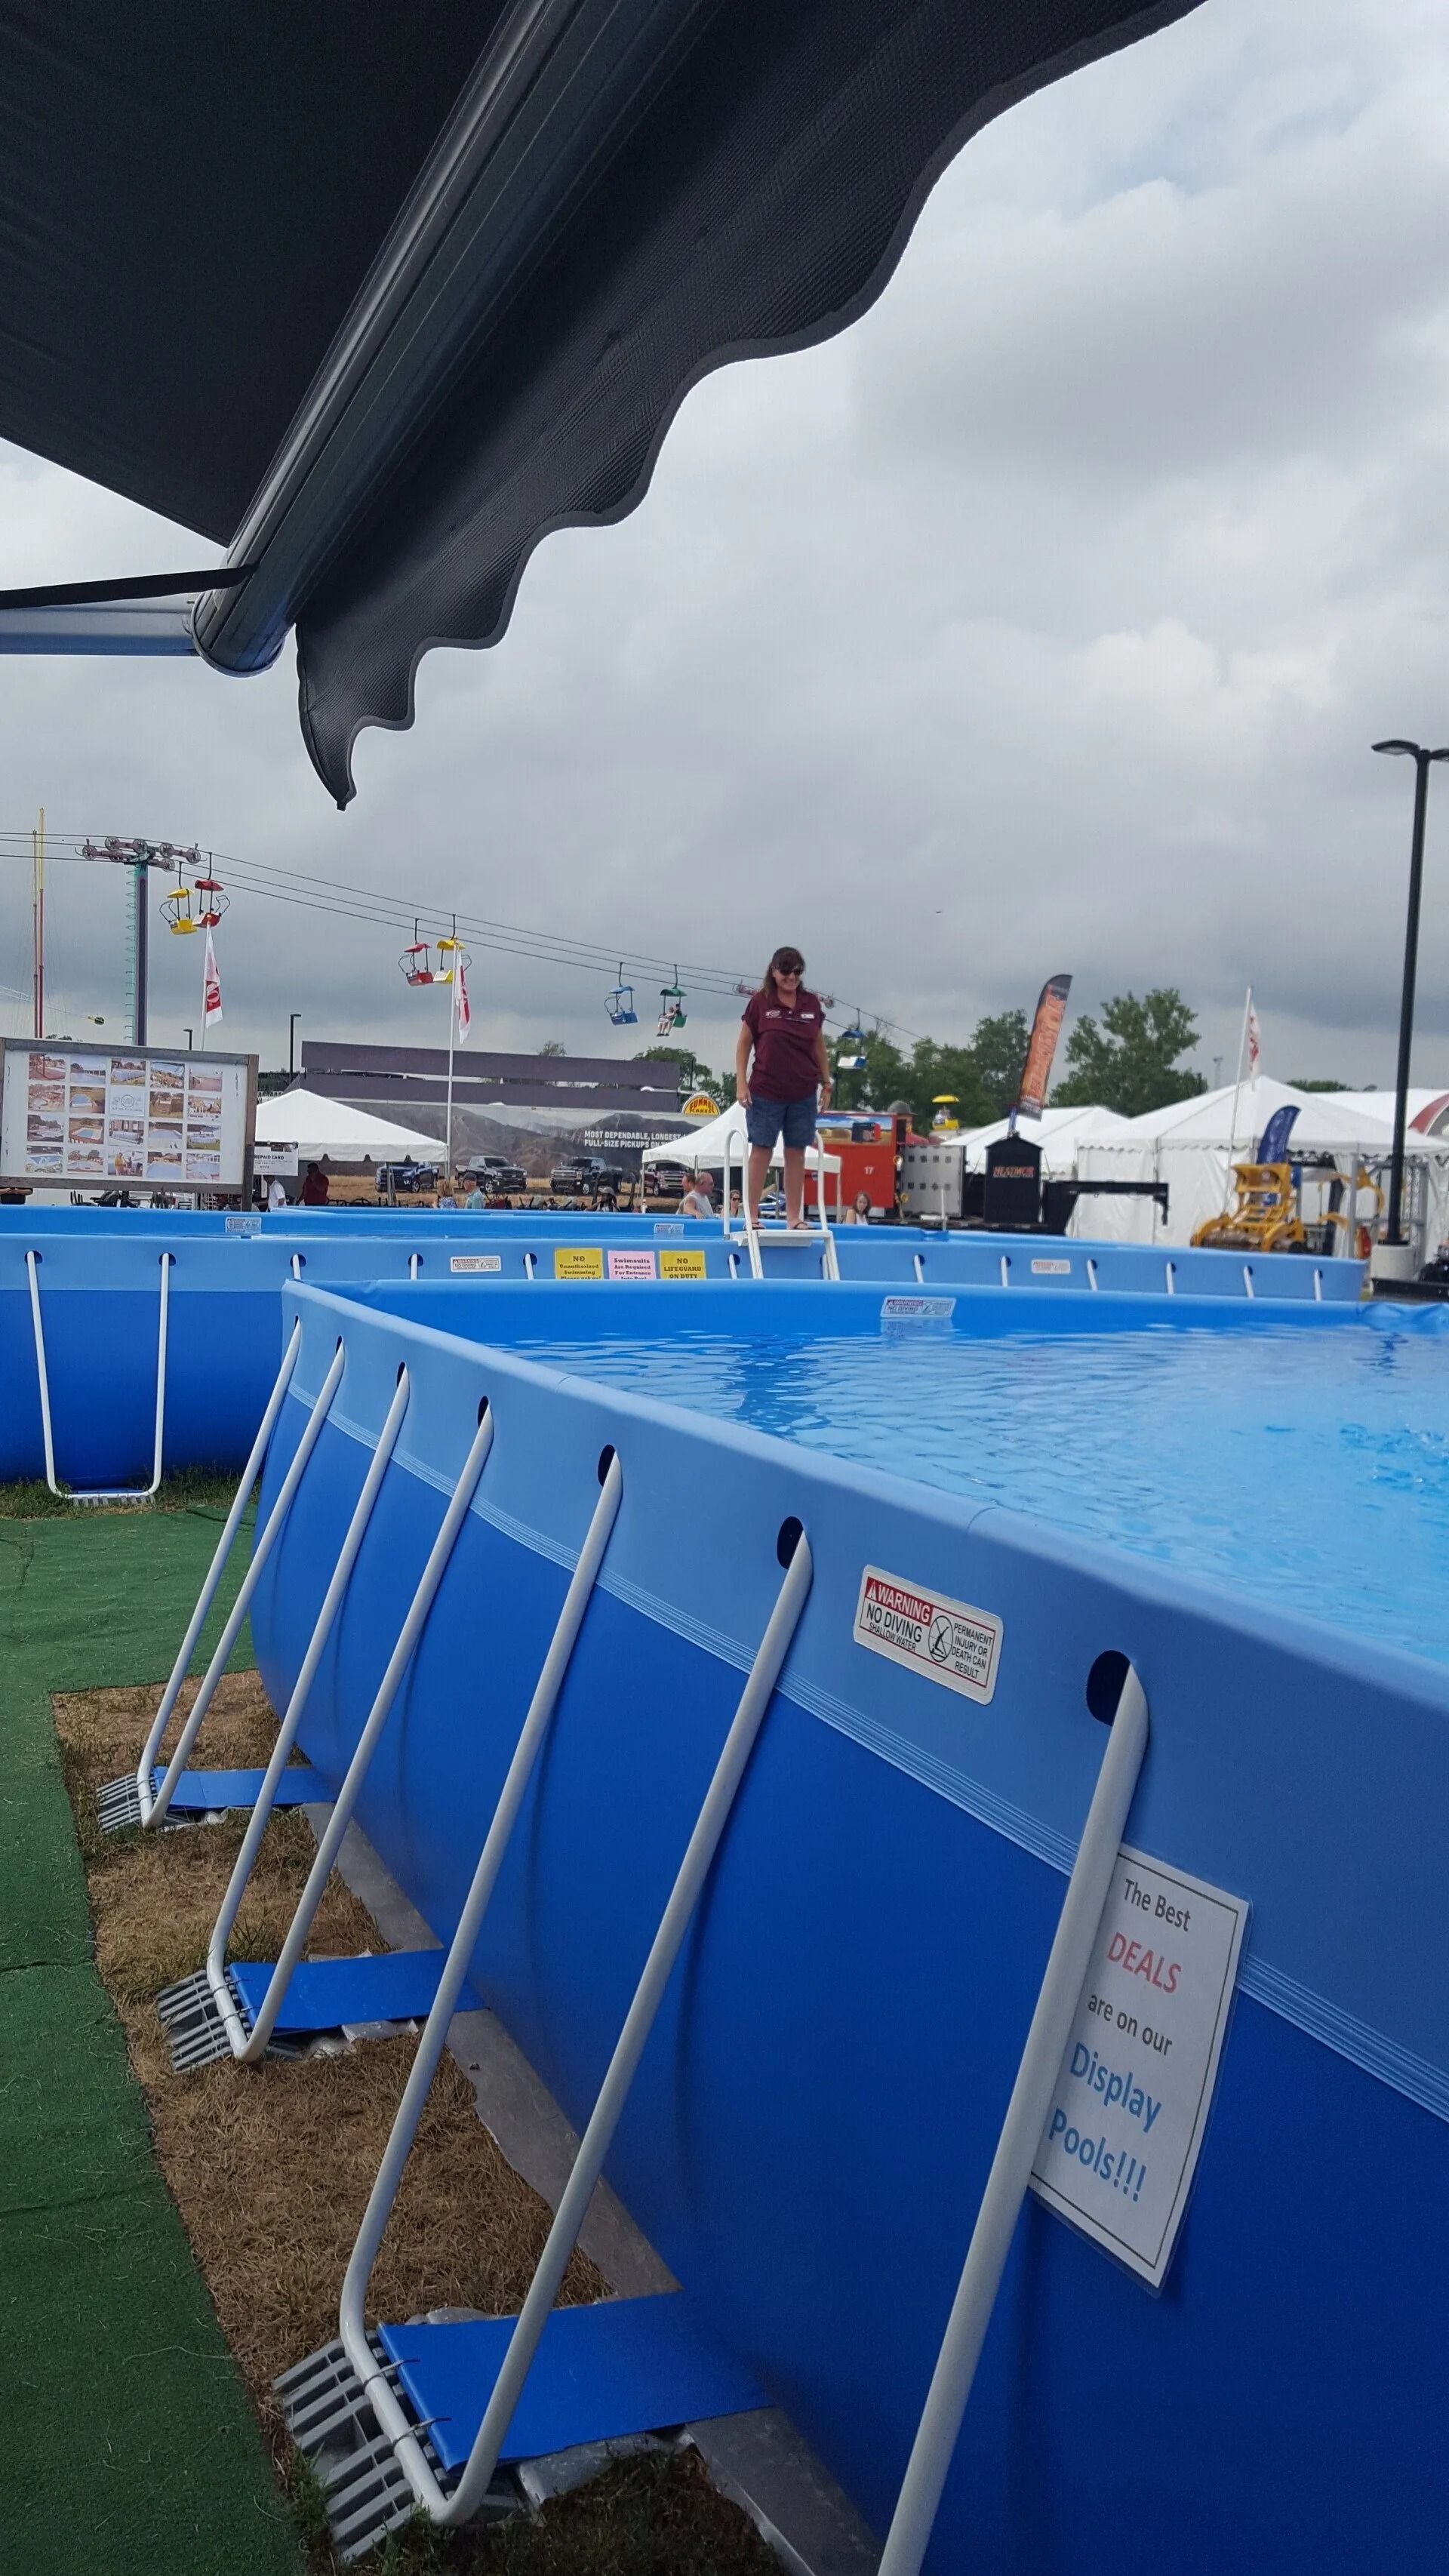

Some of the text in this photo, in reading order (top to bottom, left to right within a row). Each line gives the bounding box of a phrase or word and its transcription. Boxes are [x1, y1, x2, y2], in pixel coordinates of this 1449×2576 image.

[584, 1139, 619, 1147] FULL-SIZE
[605, 1131, 651, 1141] DEPENDABLE,
[864, 1166, 874, 1174] 17
[878, 1583, 931, 1623] WARNING
[867, 1602, 922, 1642] NO DIVING
[869, 1621, 916, 1651] SHALLOW WATER
[953, 1622, 993, 1647] PERMANENT
[951, 1645, 986, 1670] DEATH CAN
[955, 1635, 988, 1657] INJURY OR
[955, 1660, 980, 1679] RESULT
[1123, 1878, 1192, 1932] The Best
[1107, 1931, 1182, 1994] DEALS
[1088, 1993, 1173, 2057] are on our
[1069, 2041, 1162, 2134] Display
[1048, 2108, 1146, 2202] Pools!!!
